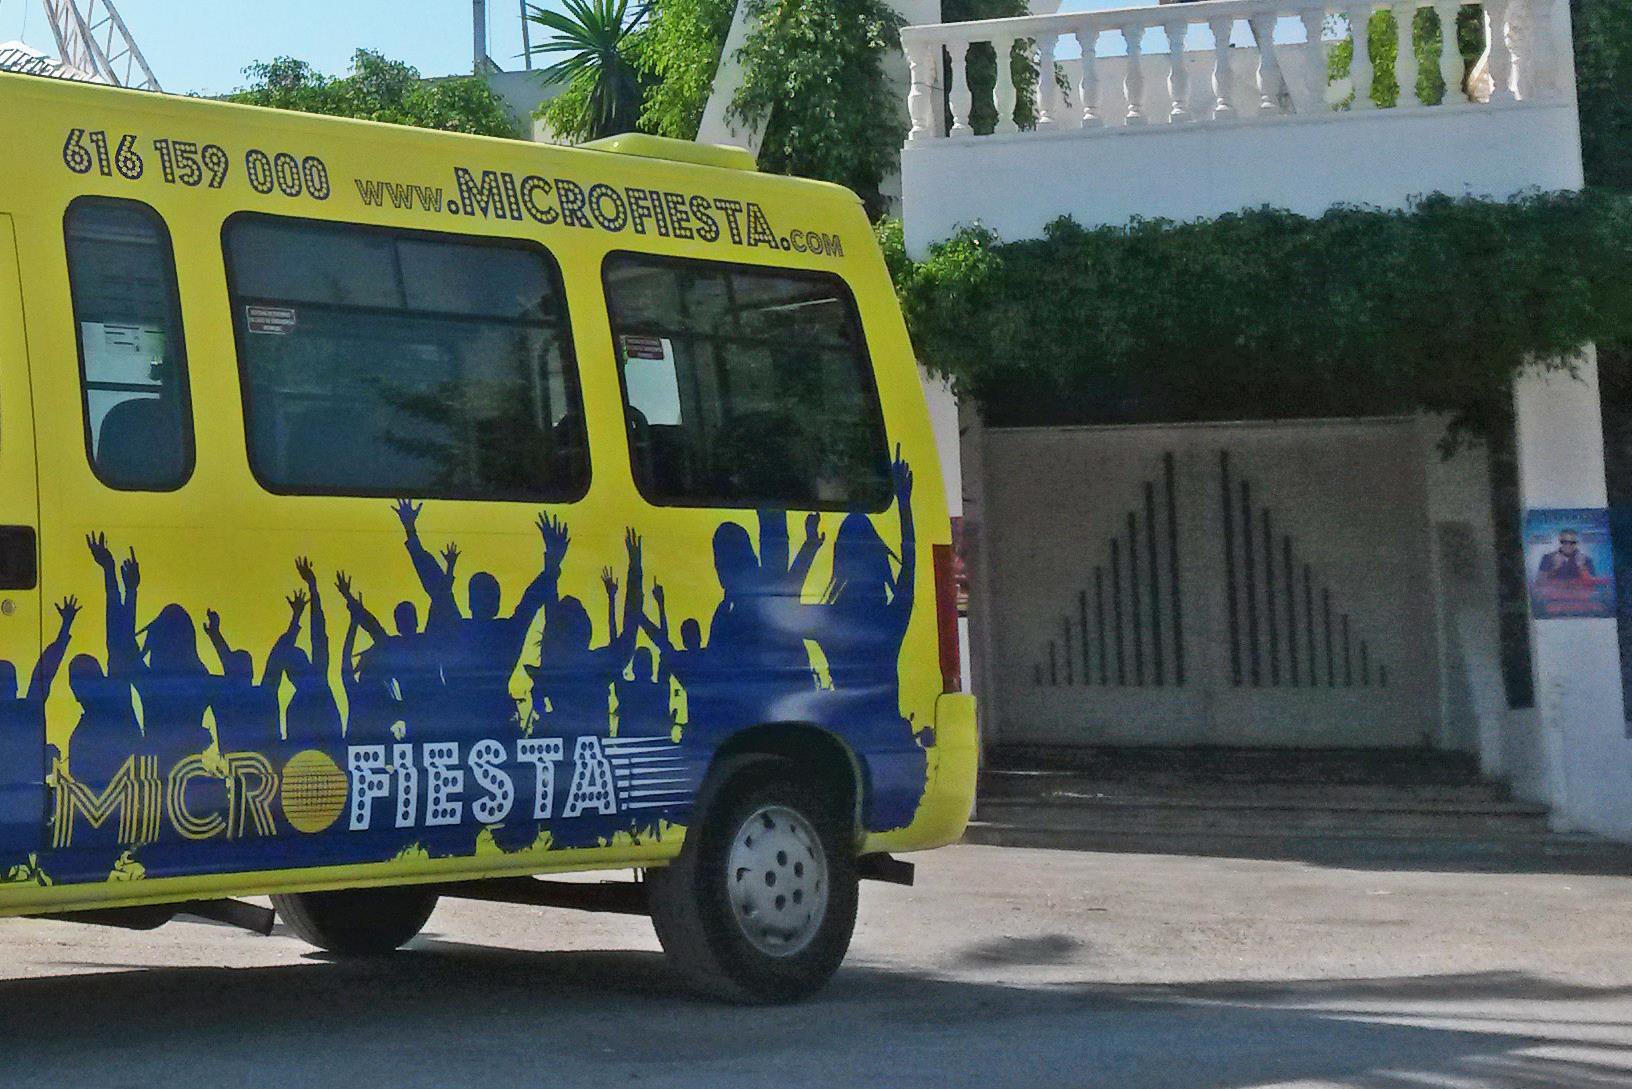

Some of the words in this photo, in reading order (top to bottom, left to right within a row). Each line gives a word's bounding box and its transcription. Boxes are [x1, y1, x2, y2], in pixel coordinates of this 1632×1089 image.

[63, 128, 145, 180] 616
[153, 138, 229, 188] 159
[245, 149, 330, 200] 000
